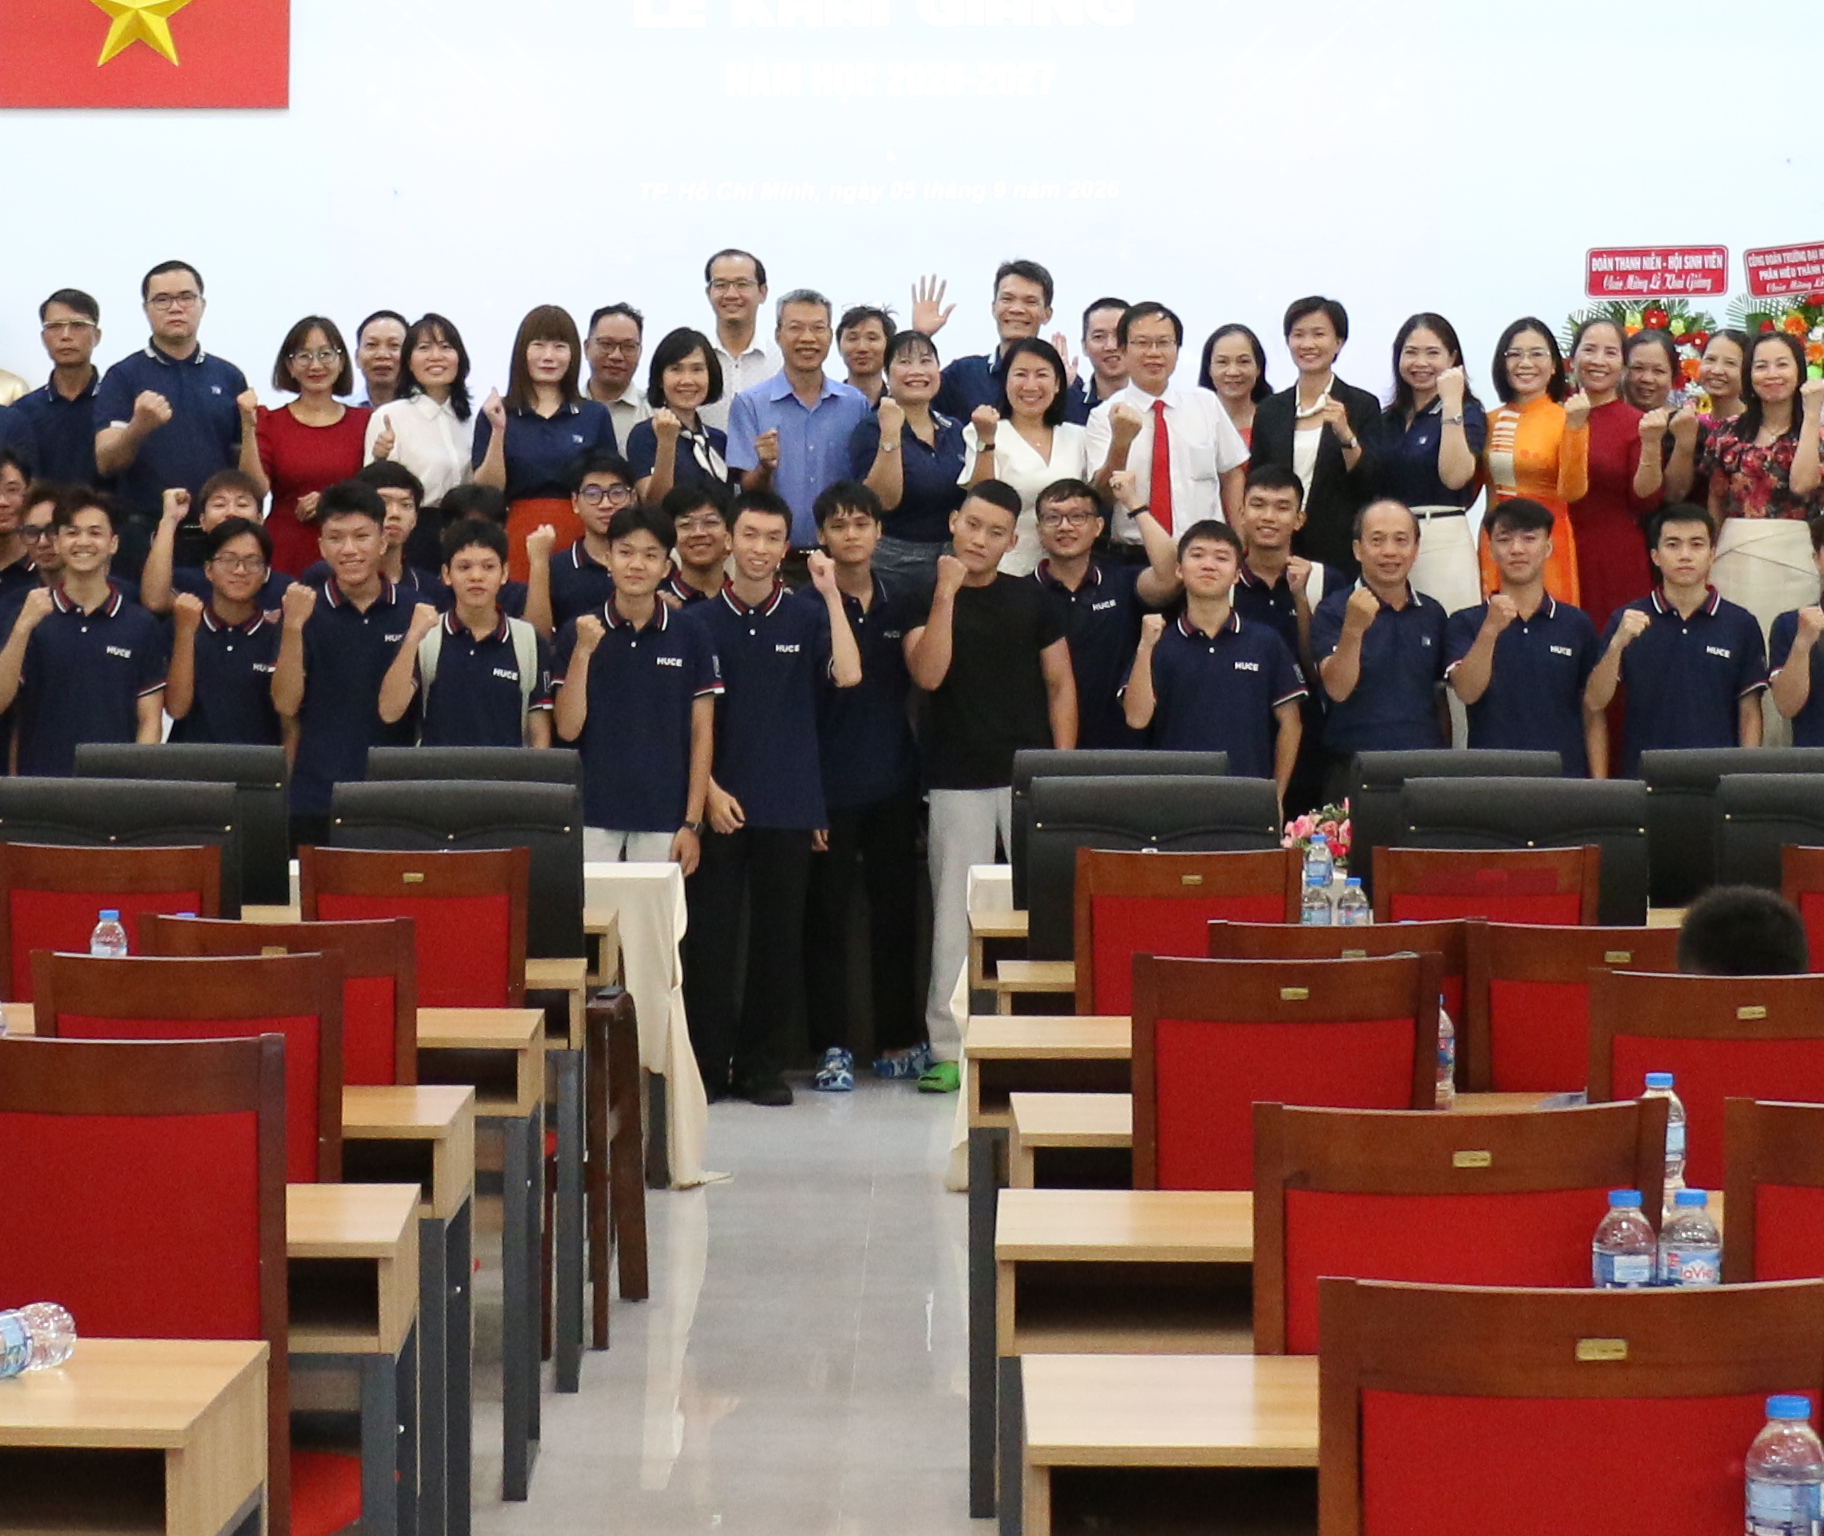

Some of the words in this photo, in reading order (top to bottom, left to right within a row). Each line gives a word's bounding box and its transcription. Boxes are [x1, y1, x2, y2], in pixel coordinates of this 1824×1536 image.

[1092, 599, 1116, 611] HUCE
[106, 645, 131, 658] HUCE
[775, 644, 800, 653] HUCE
[1550, 645, 1572, 656] HUCE
[1706, 645, 1730, 658] HUCE
[656, 657, 682, 667] HUCE
[1234, 661, 1259, 671] HUCE
[493, 667, 518, 680] HUCE
